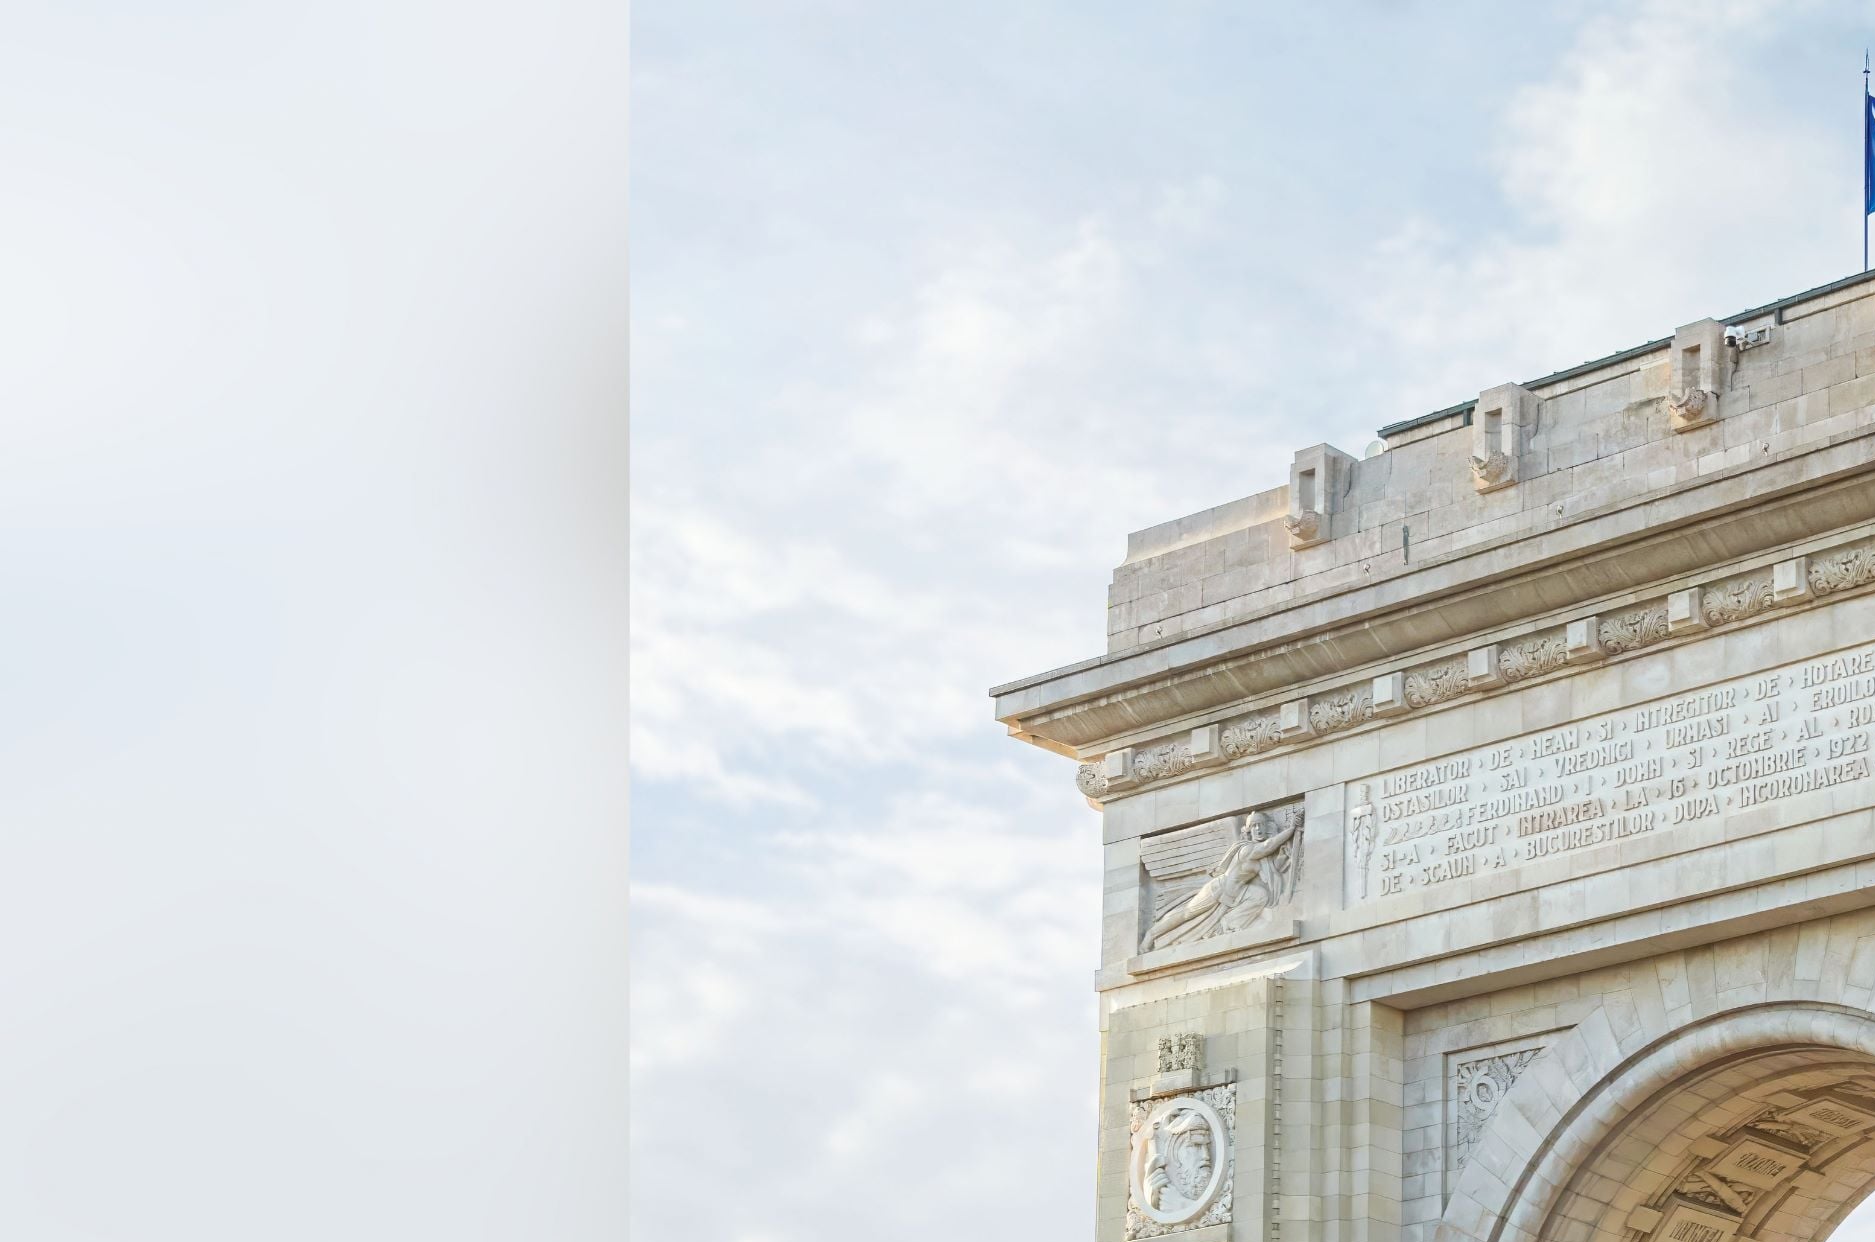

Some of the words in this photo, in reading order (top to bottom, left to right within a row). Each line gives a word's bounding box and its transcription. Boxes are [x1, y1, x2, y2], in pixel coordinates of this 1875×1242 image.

[1381, 757, 1470, 798] LIBERATOR
[1488, 746, 1513, 771] DE
[1531, 727, 1579, 760] NEAM
[1600, 719, 1614, 742] SI
[1634, 688, 1736, 733] INTREGITOR
[1754, 675, 1781, 701] DE
[1800, 651, 1875, 689] HOTARE
[1383, 783, 1468, 822] OSTASILOR
[1500, 767, 1527, 792] SAI
[1555, 740, 1633, 778] VREDNICI
[1664, 714, 1729, 749] URMASI
[1759, 702, 1779, 725] AI
[1467, 783, 1564, 825] FERDINAND
[1614, 757, 1663, 788] DOMN
[1687, 746, 1703, 769] SI
[1725, 728, 1773, 759] REGE
[1796, 717, 1823, 742] AL
[1380, 872, 1403, 896] DE
[1422, 854, 1475, 885] SCAUN
[1494, 847, 1507, 868] A
[1525, 810, 1654, 860] BUCURESTILOR
[1673, 794, 1720, 825] DUPA
[1739, 757, 1870, 808] INCORONAREA
[1445, 824, 1498, 855] FACUT
[1517, 798, 1604, 838] INTRAREA
[1624, 786, 1648, 811] LA
[1668, 777, 1685, 800] 16
[1705, 746, 1806, 790] OCTOMBRIE
[1827, 731, 1869, 760] 1922
